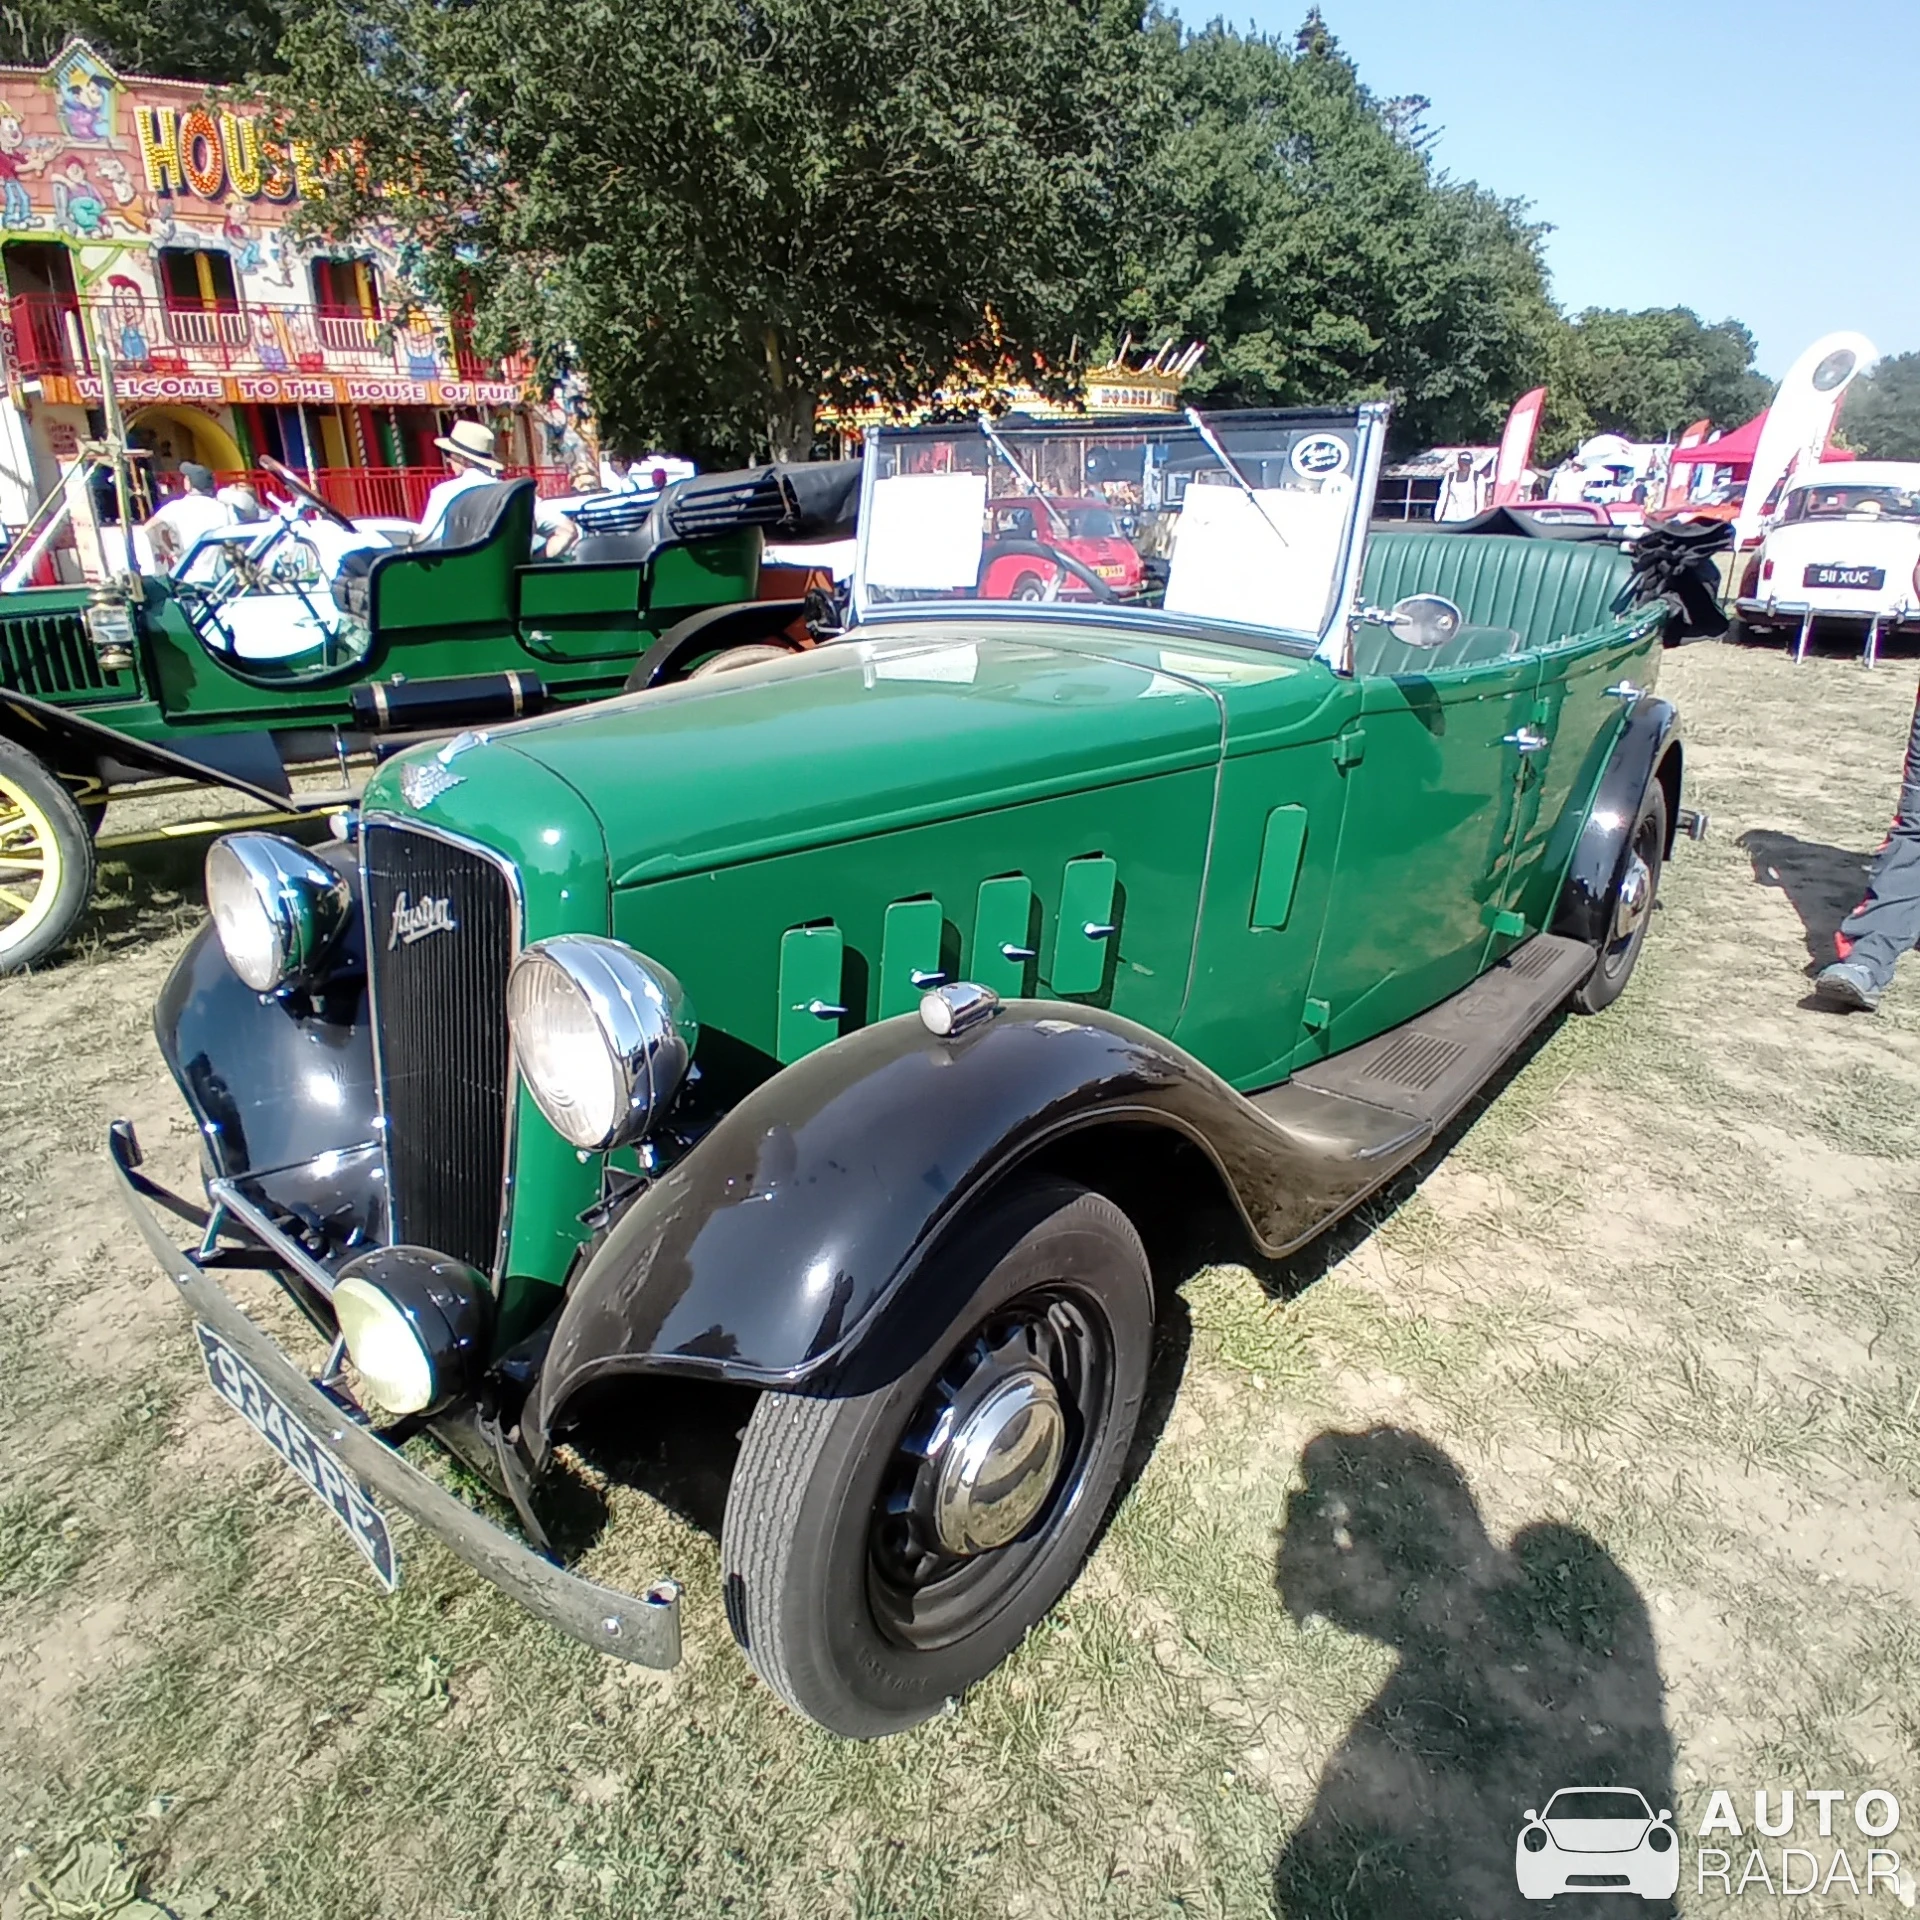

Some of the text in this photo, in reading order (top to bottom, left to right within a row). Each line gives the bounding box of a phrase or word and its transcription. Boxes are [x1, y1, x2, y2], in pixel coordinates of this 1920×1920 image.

[77, 378, 518, 402] WELCOME TO THE HOUSE OF FUN
[1818, 569, 1870, 584] 511 XUC
